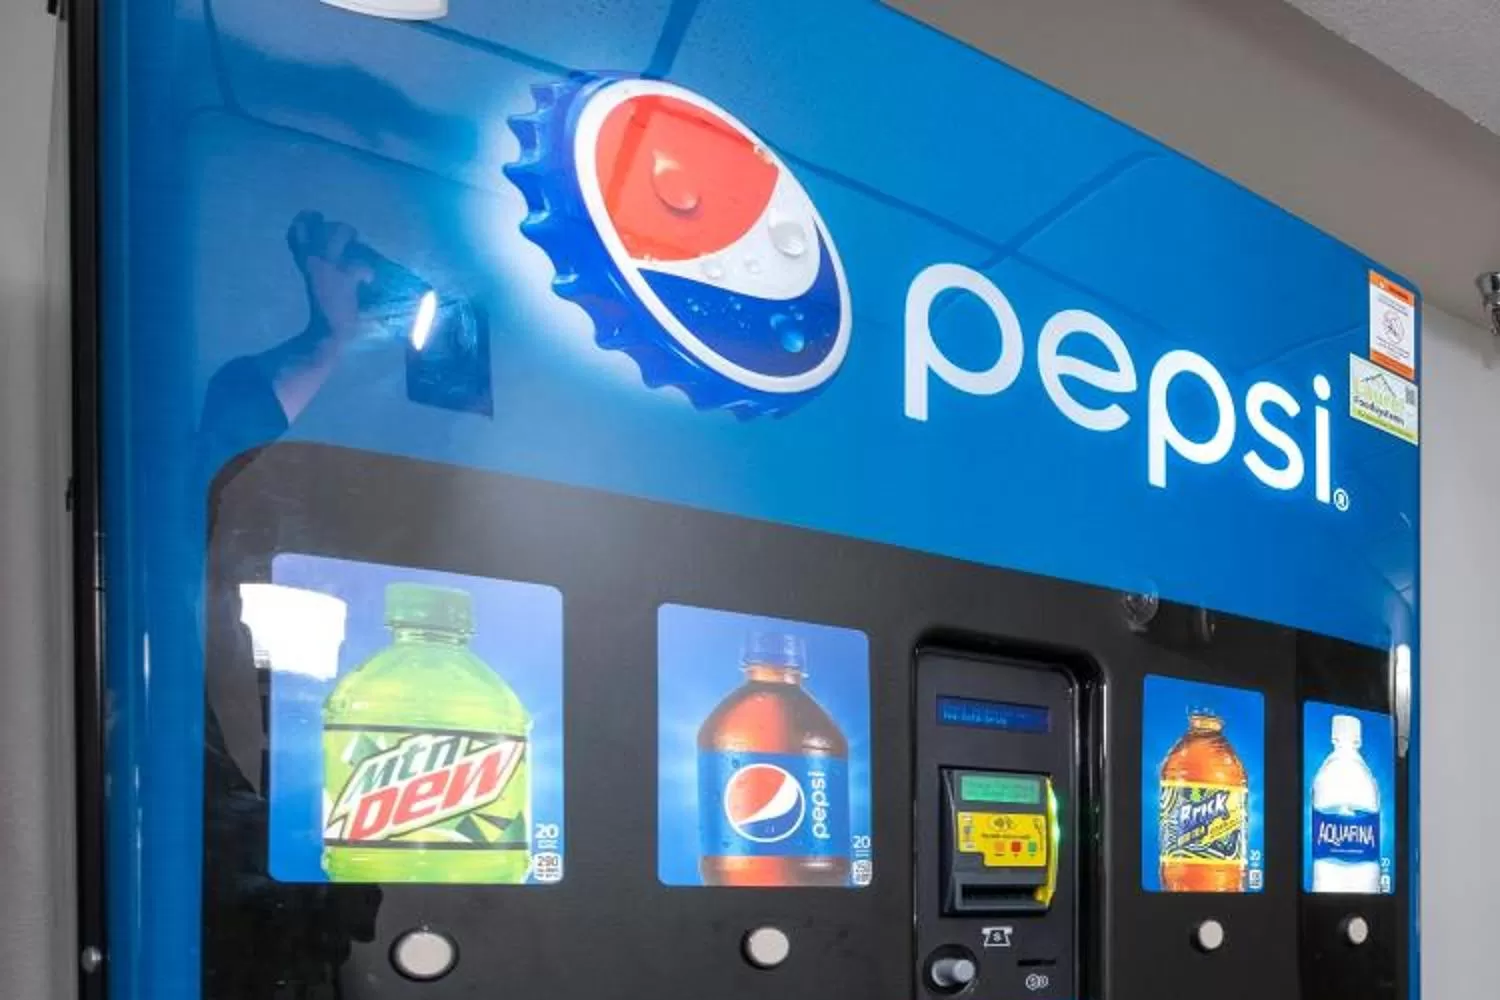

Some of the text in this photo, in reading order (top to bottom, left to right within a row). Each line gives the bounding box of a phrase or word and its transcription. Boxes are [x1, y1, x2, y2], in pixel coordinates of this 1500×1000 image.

[904, 262, 1331, 504] pepsi
[807, 769, 831, 839] pepsi
[535, 823, 559, 838] 20
[852, 835, 871, 849] 20
[1317, 821, 1375, 848] AQUAFINA
